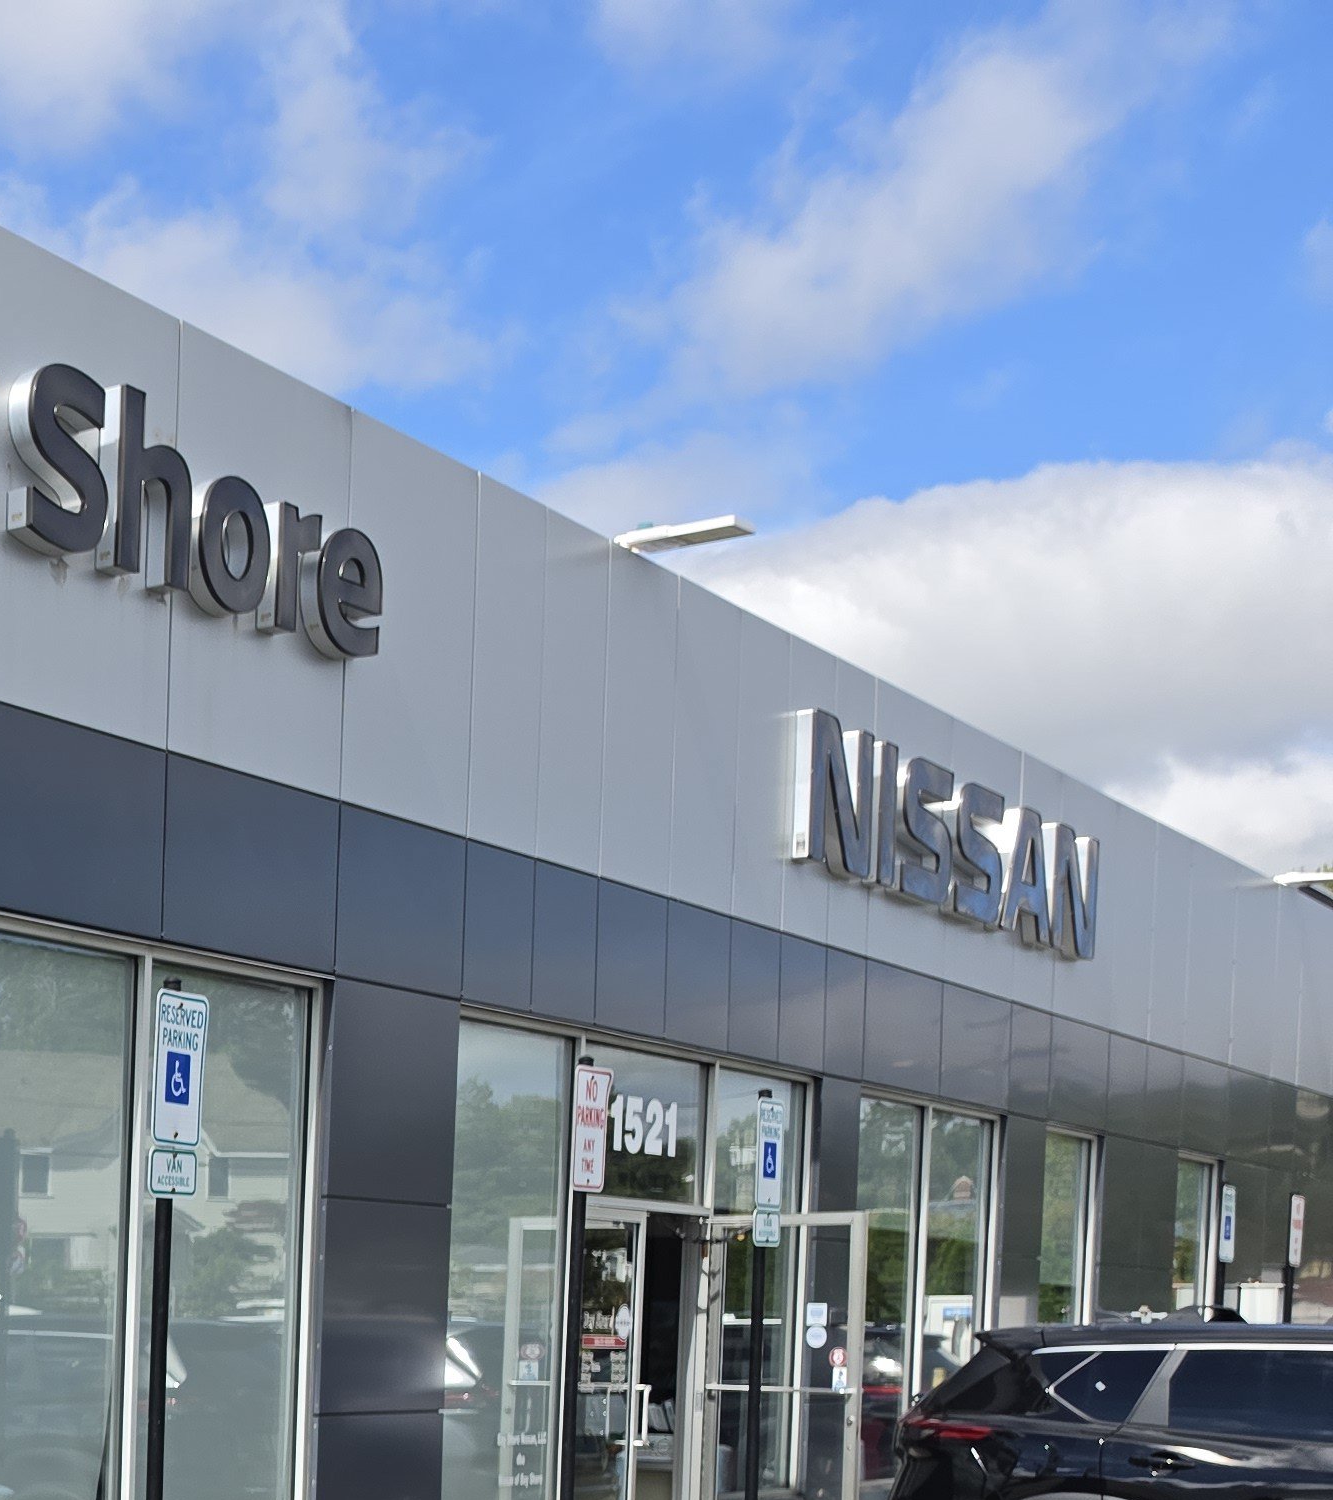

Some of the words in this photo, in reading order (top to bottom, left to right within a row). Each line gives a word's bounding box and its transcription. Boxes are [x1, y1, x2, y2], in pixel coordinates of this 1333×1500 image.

[6, 362, 383, 660] Shore
[791, 708, 1100, 960] NISSAN
[160, 1003, 204, 1030] RESERVED
[162, 1027, 200, 1052] PARKING
[586, 1079, 599, 1102] NO
[577, 1105, 605, 1130] PARKING
[610, 1094, 678, 1158] 1521
[583, 1138, 596, 1153] ANY
[166, 1158, 183, 1173] VAN
[581, 1156, 595, 1174] TIME
[157, 1174, 190, 1188] ACCESSIBLE
